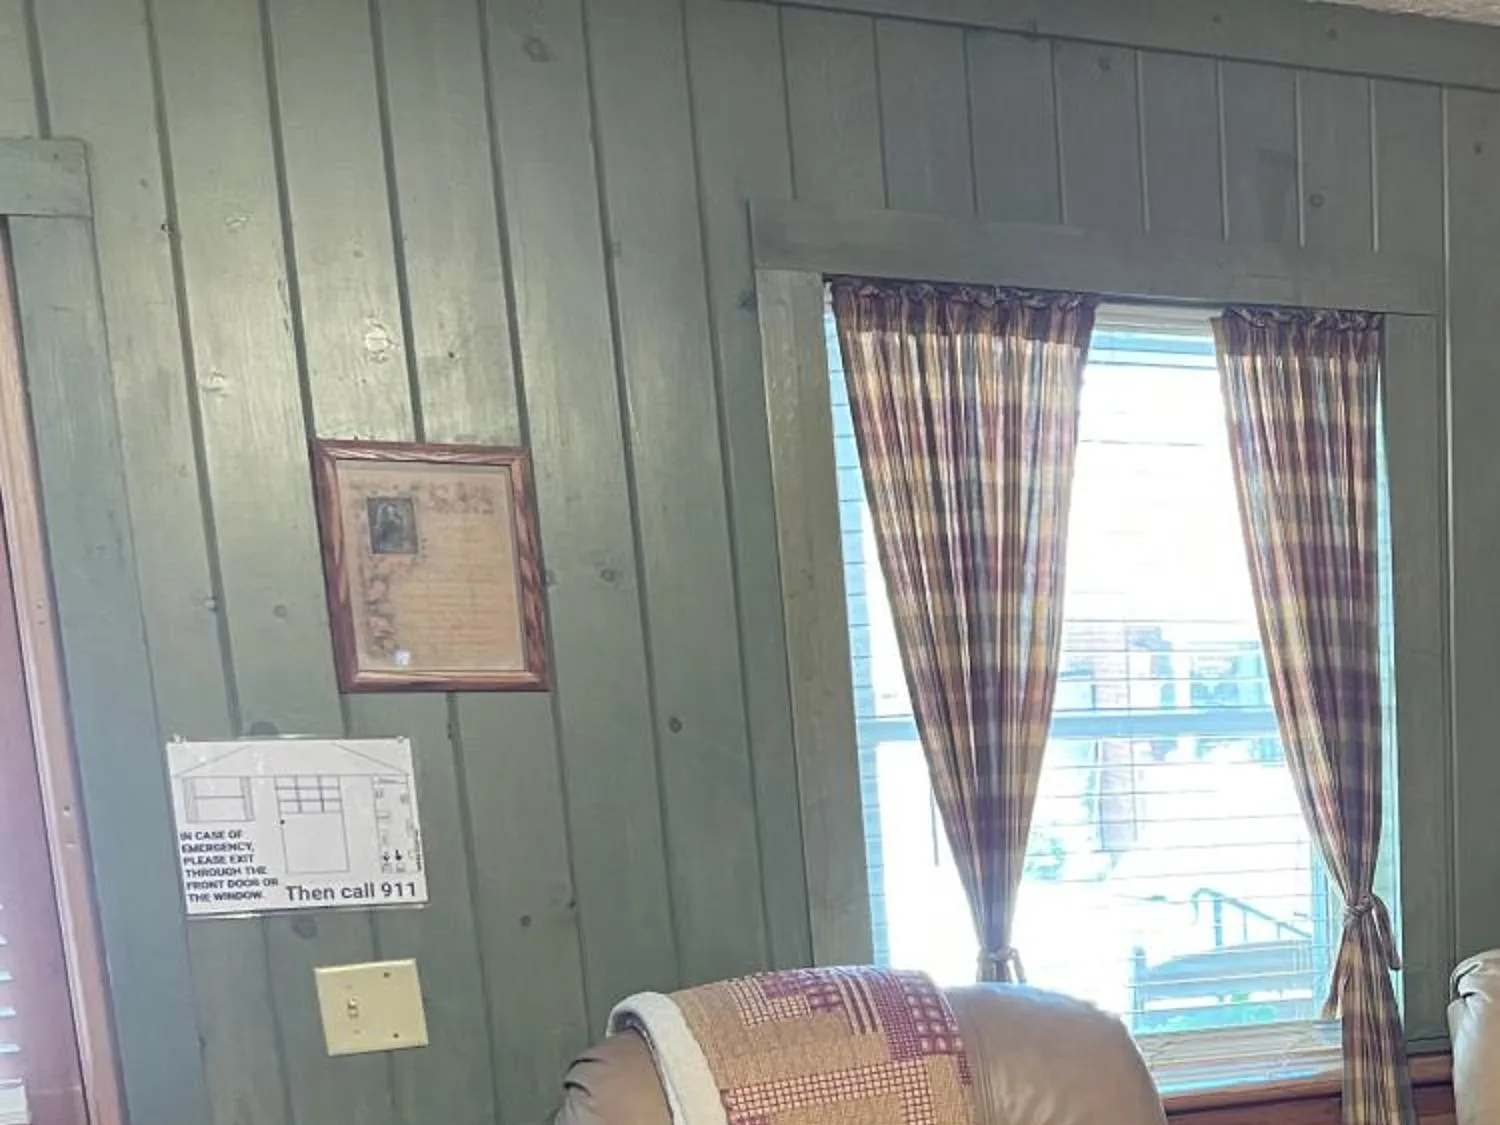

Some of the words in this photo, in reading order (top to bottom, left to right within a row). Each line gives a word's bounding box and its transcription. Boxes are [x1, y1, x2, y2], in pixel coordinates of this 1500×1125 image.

[195, 831, 223, 840] CASE
[228, 830, 242, 839] OF
[184, 855, 225, 865] PLEASE
[245, 866, 267, 875] THE
[187, 880, 224, 890] FRONT
[286, 884, 334, 901] Then
[341, 881, 374, 899] call
[381, 881, 415, 898] 911
[189, 893, 211, 902] THE
